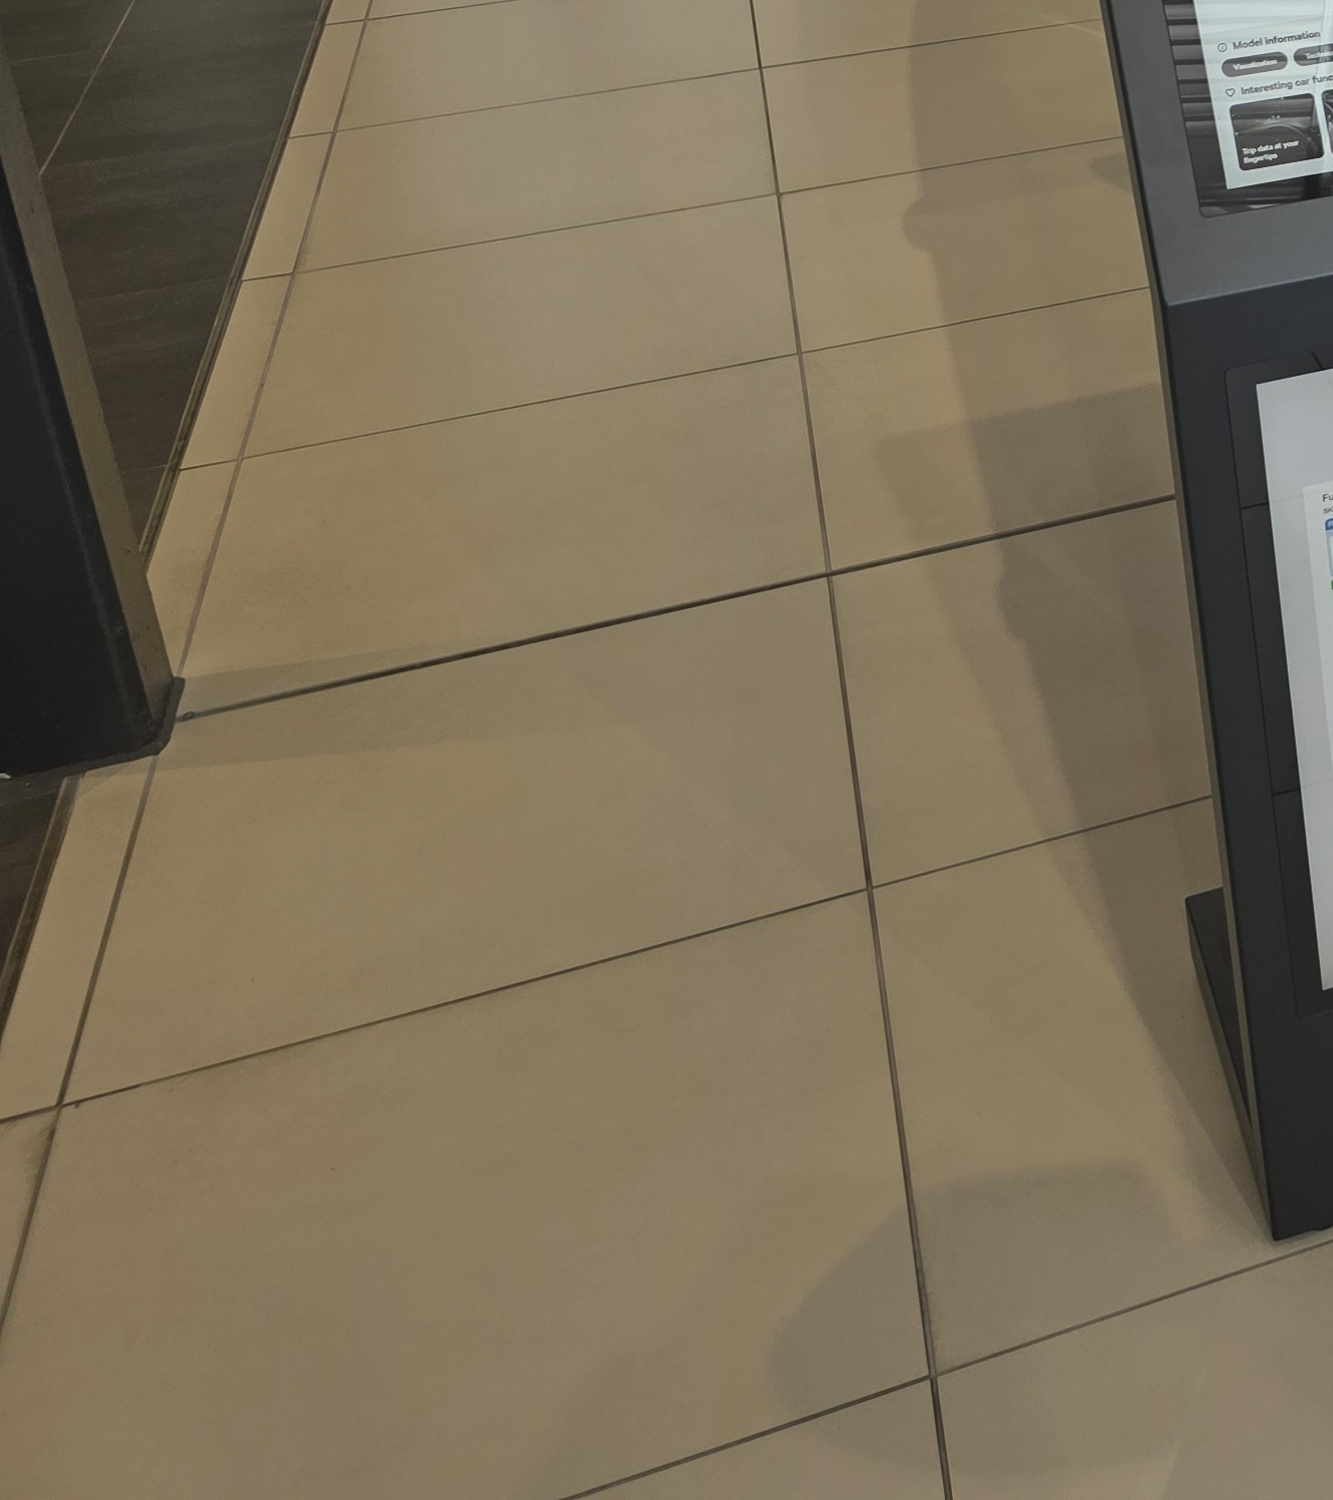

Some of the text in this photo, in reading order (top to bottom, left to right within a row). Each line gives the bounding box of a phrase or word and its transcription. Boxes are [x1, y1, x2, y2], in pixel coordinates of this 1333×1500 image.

[1232, 30, 1320, 49] Model information
[1241, 80, 1293, 95] Interesting
